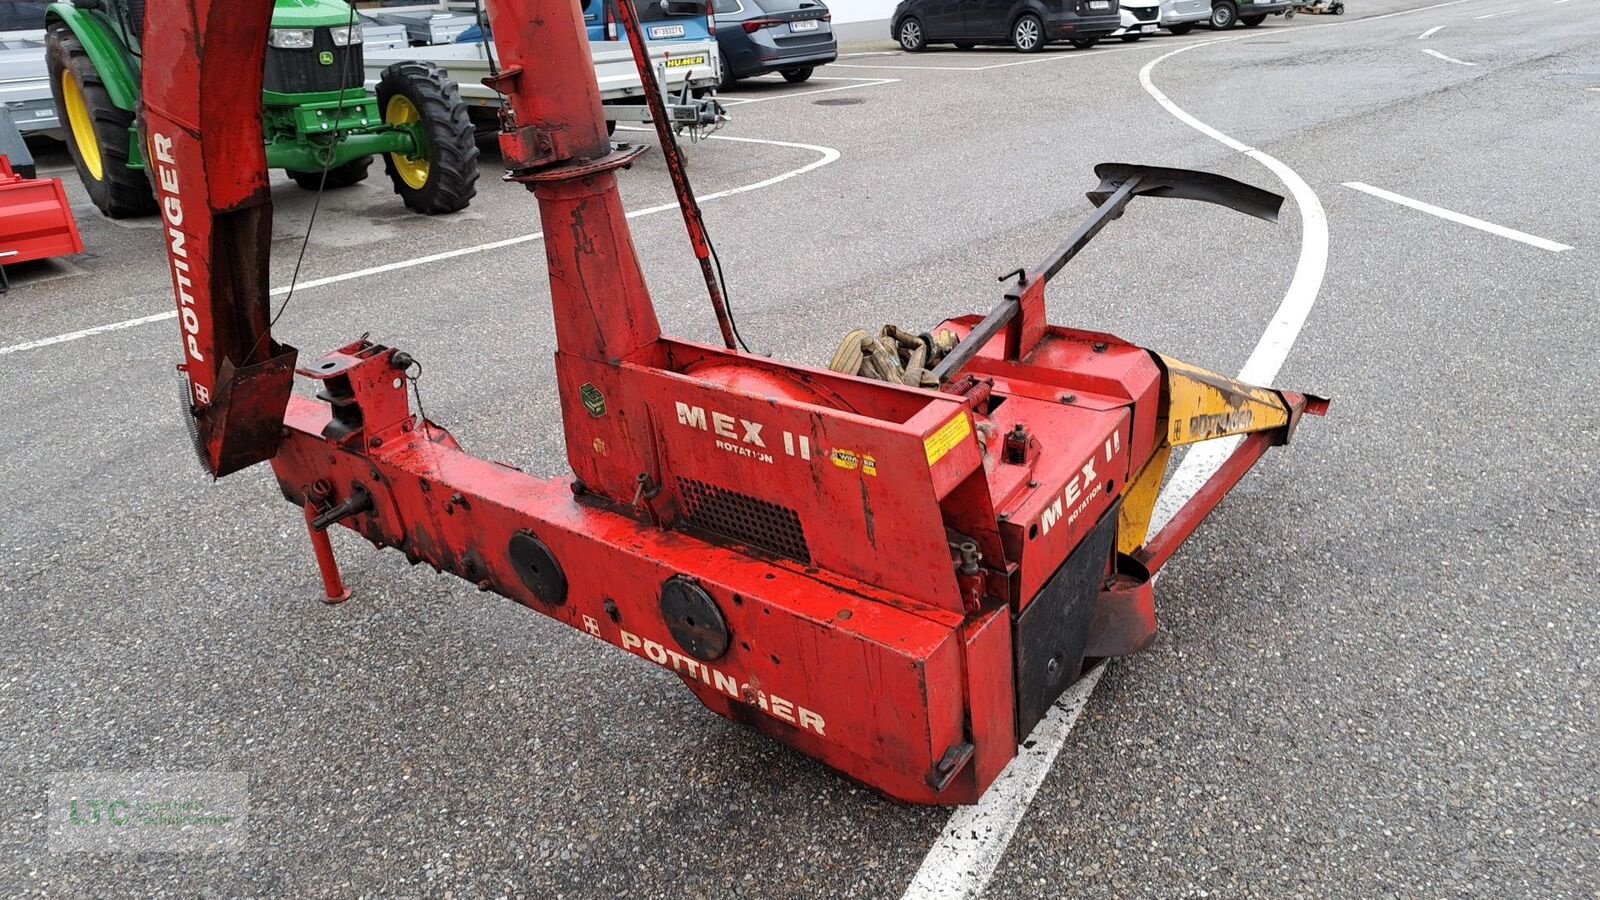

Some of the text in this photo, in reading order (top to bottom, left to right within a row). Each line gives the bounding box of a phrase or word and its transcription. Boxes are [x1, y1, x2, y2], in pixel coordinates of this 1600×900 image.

[667, 57, 703, 67] HUMER
[675, 401, 811, 461] MEX II
[715, 439, 774, 464] ROTATION
[838, 453, 875, 468] WIMER
[1041, 429, 1121, 536] MEX II
[1067, 482, 1103, 526] ROTATION
